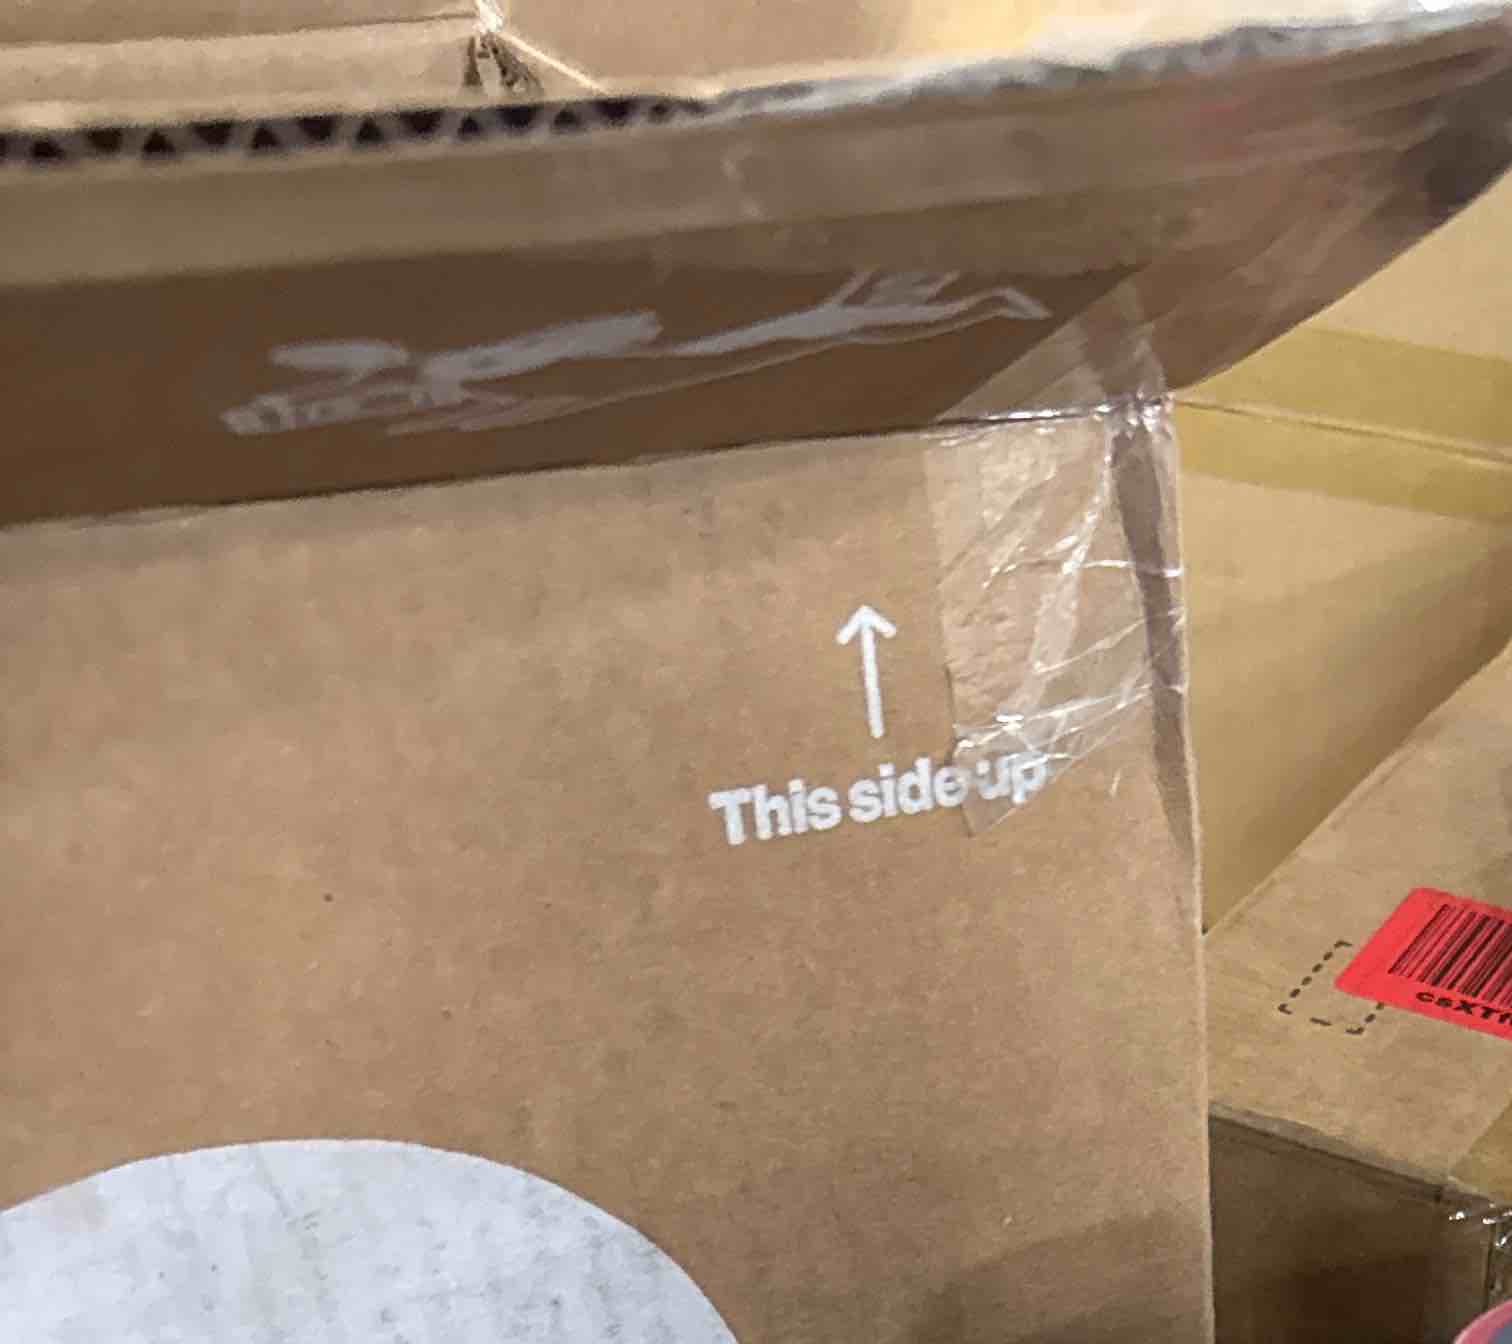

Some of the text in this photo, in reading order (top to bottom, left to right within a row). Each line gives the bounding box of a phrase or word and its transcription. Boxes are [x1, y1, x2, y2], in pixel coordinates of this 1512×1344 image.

[708, 752, 1050, 846] This side up
